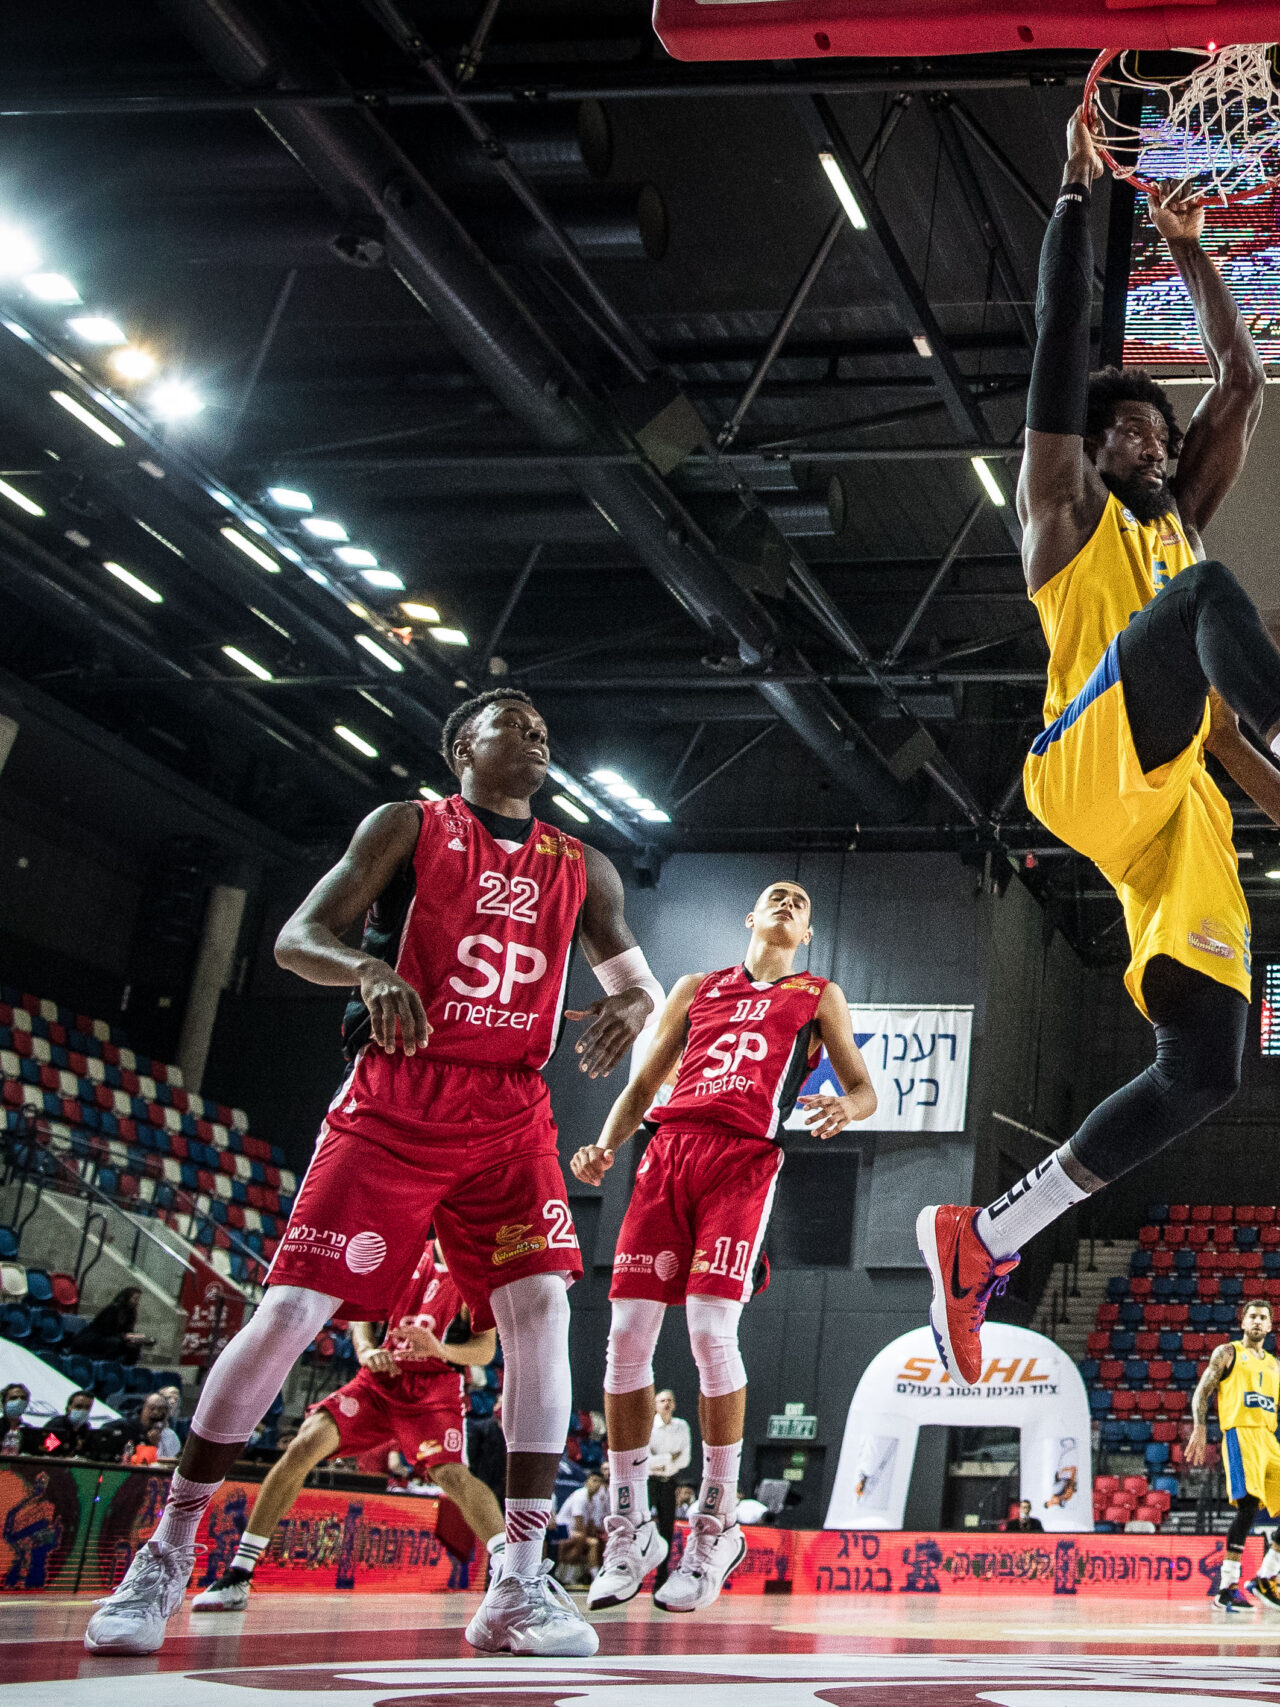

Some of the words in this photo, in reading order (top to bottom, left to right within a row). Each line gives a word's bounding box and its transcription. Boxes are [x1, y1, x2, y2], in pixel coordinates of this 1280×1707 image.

[476, 870, 540, 924] 22
[449, 933, 548, 1004] SP
[443, 1000, 539, 1031] metzer
[729, 999, 771, 1022] 11
[702, 1031, 769, 1079] SP
[881, 1032, 957, 1070] רענן
[694, 1073, 755, 1097] metzer
[892, 1077, 940, 1116] כץ
[542, 1199, 580, 1249] 2
[709, 1236, 750, 1282] 11
[897, 1357, 1050, 1384] SHL
[838, 1533, 880, 1560] סיג
[816, 1566, 893, 1592] בגובה
